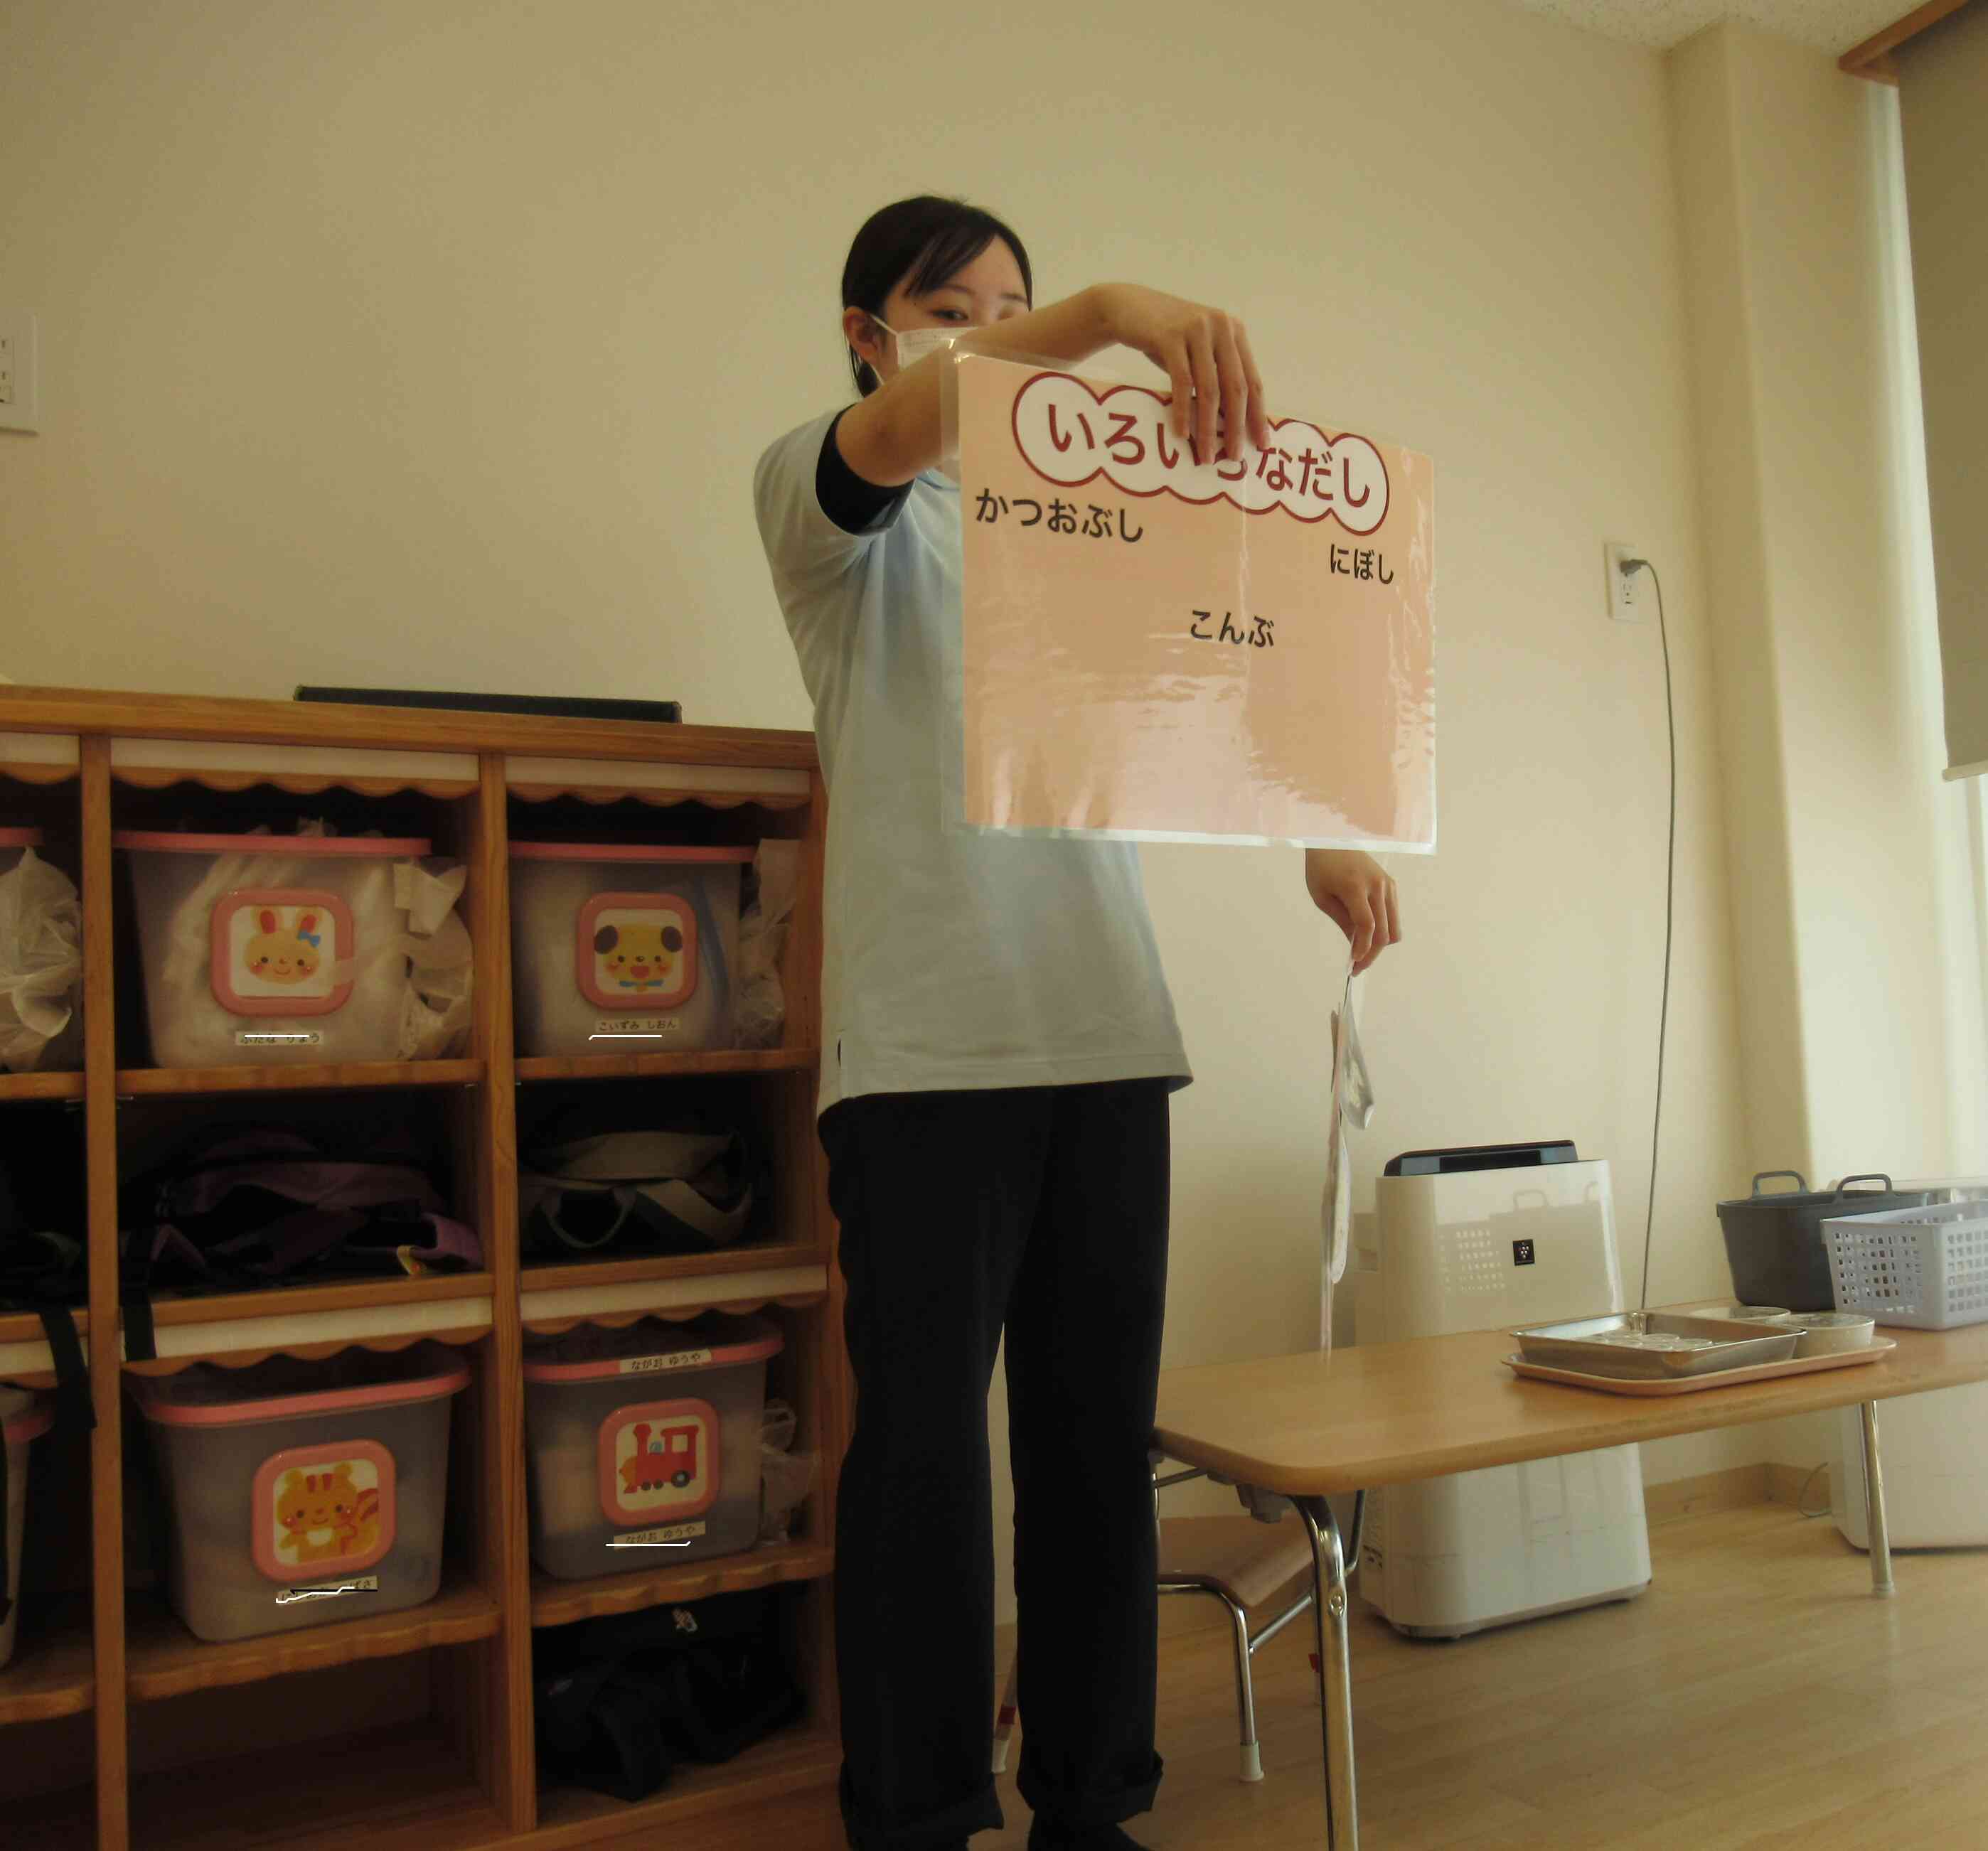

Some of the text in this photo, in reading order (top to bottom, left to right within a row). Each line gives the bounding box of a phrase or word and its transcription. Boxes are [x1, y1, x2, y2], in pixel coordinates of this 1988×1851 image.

[976, 488, 1144, 542] かつおぶし
[1330, 544, 1394, 585] にぼし
[1190, 609, 1276, 648] こんぶ
